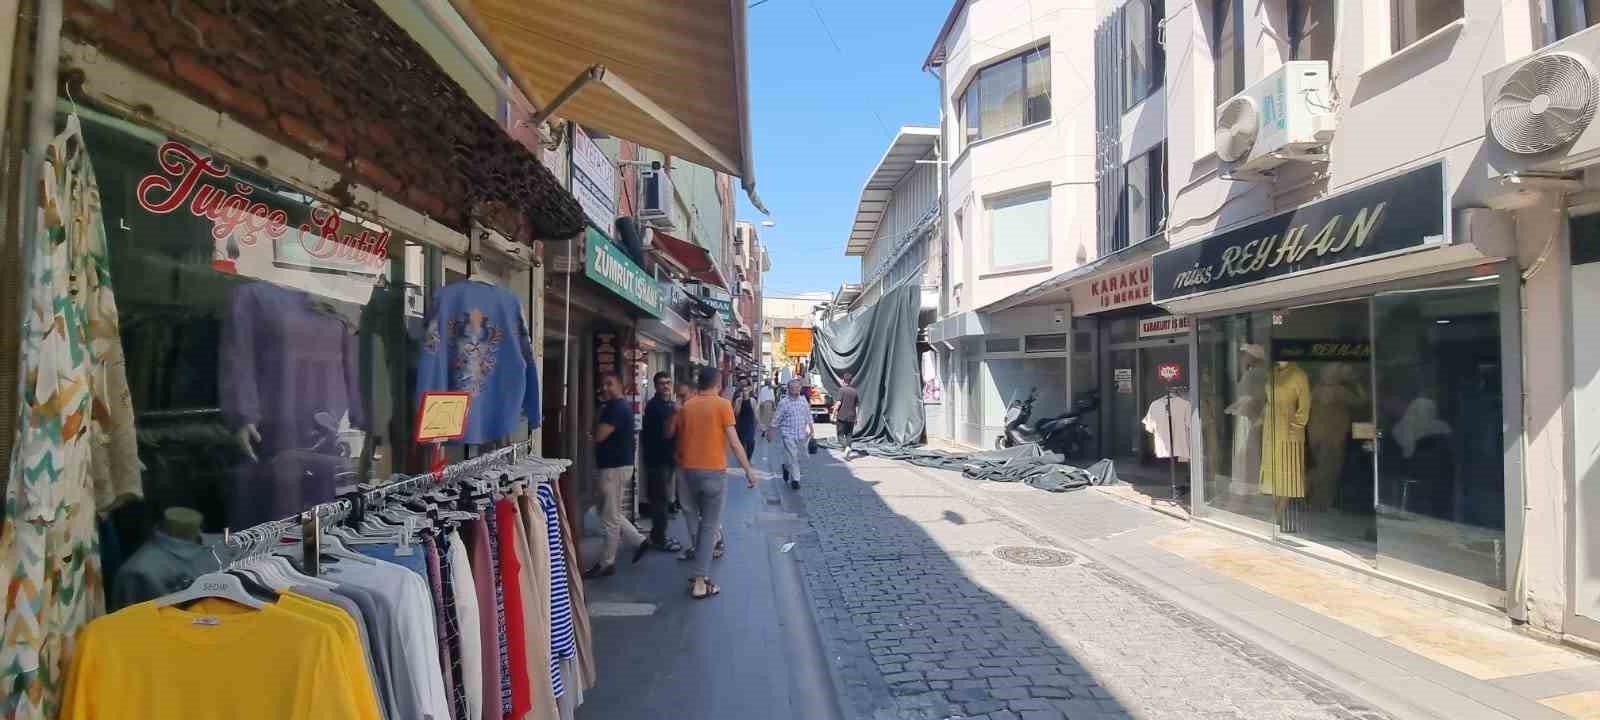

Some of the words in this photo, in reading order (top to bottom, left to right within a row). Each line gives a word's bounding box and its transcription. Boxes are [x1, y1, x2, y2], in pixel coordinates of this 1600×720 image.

[137, 141, 289, 247] Tuğçe
[297, 204, 392, 269] Butik
[1172, 262, 1213, 289] miss
[1214, 201, 1387, 280] REYHAN
[1091, 266, 1151, 297] KARAKU
